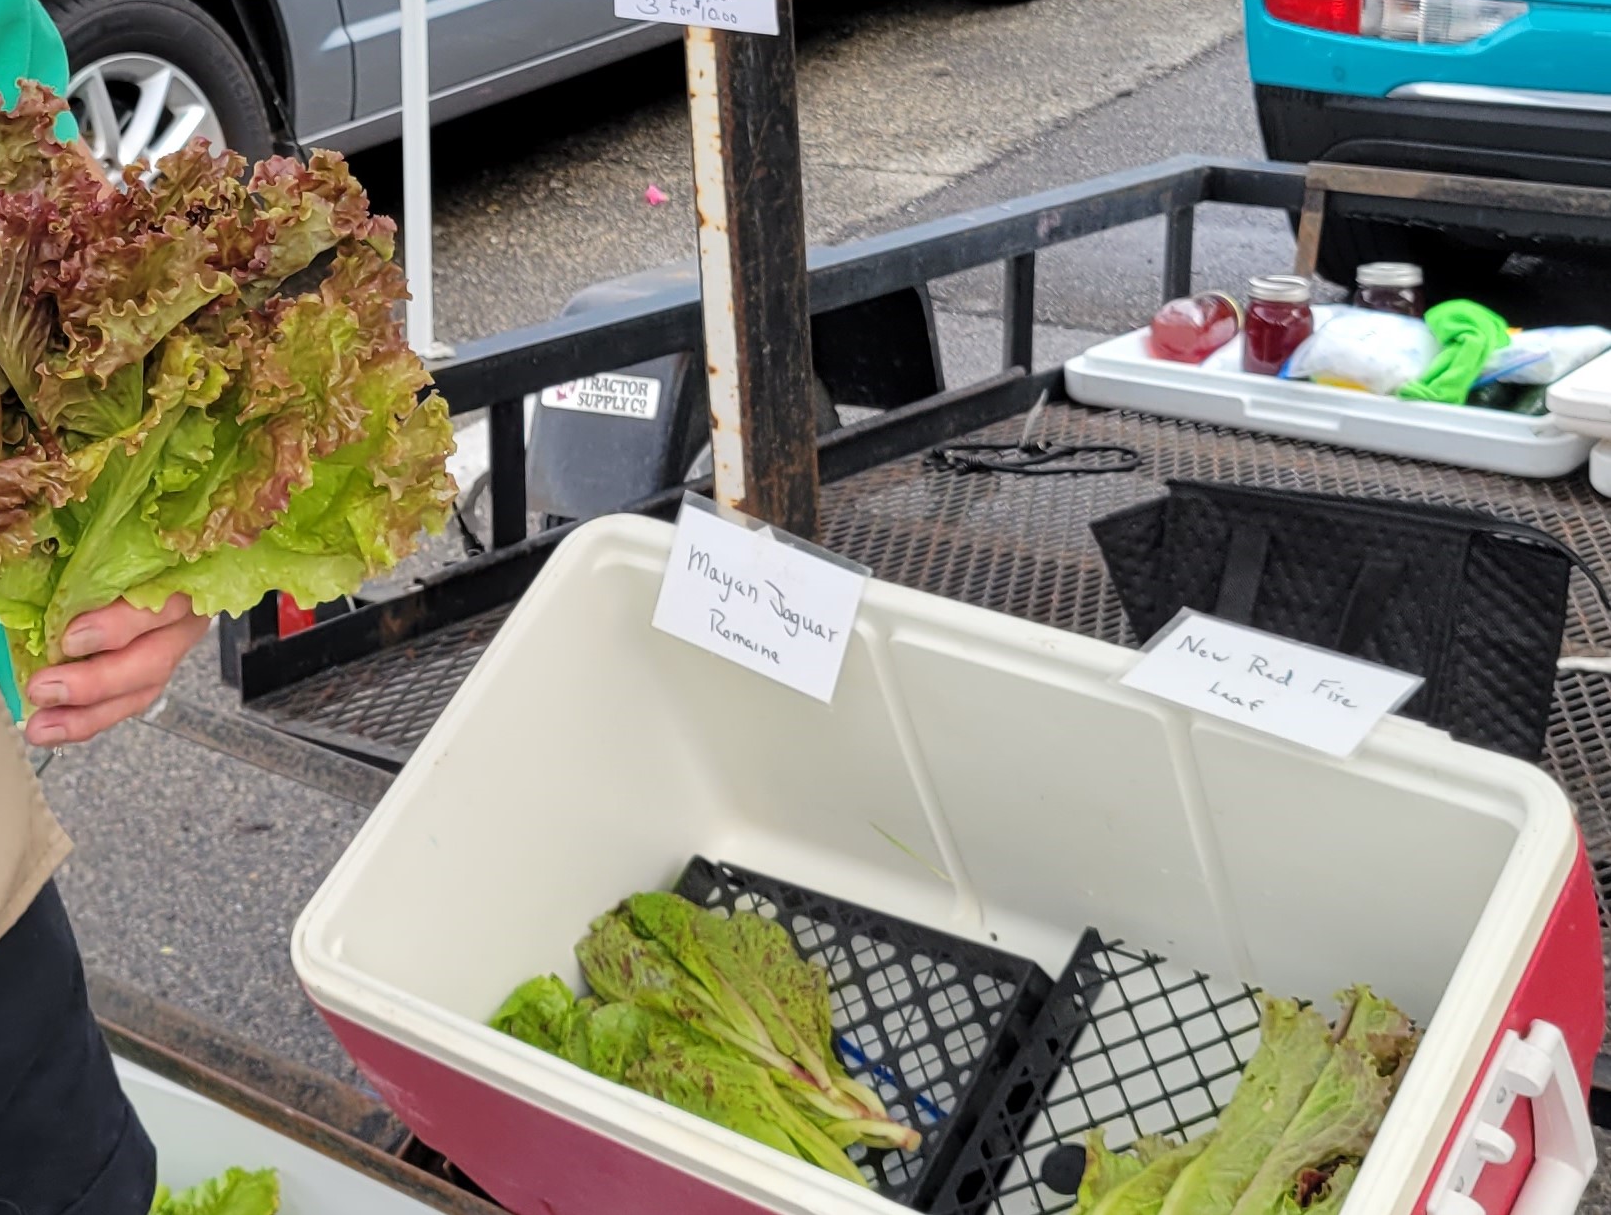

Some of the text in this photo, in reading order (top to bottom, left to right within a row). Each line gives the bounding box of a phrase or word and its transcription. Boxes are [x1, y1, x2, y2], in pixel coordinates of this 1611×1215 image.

[669, 0, 691, 17] for
[577, 392, 629, 411] SUPPLY
[582, 376, 649, 397] TRACTOR
[687, 543, 840, 643] Mayan Jaguar
[710, 608, 780, 665] Romaine
[1177, 635, 1358, 709] New Red Fire
[1208, 681, 1265, 712] Leaf
